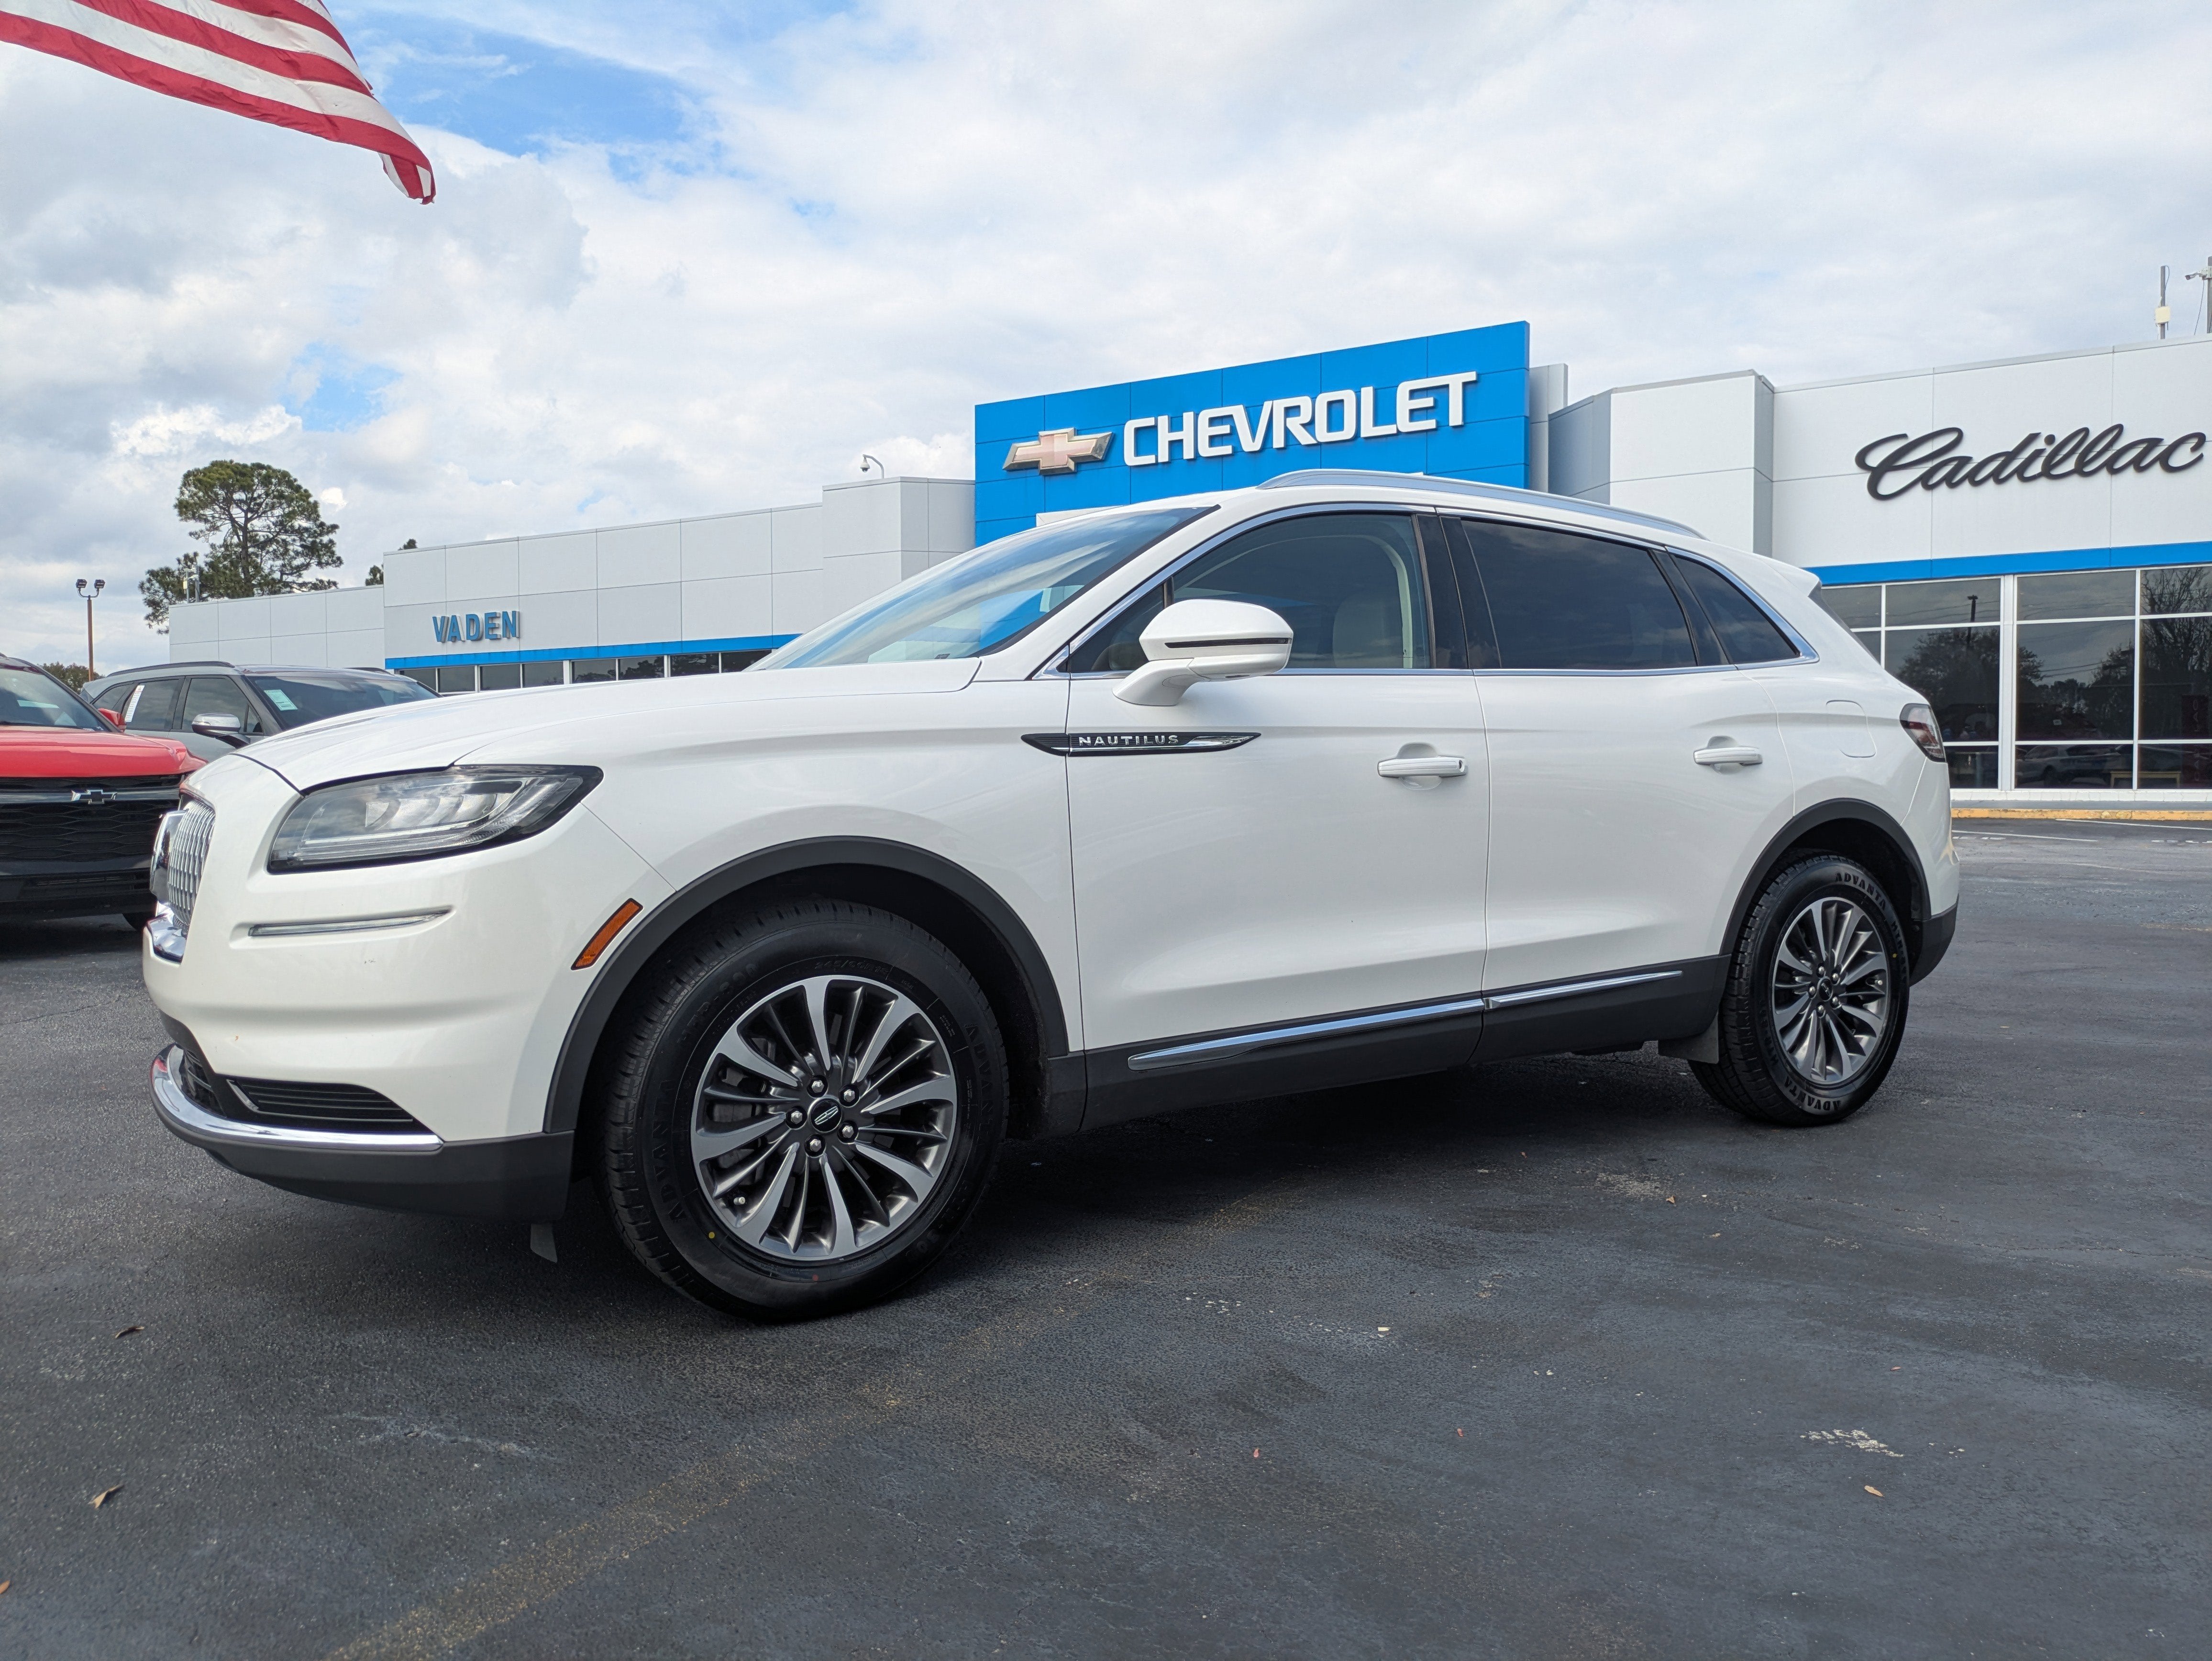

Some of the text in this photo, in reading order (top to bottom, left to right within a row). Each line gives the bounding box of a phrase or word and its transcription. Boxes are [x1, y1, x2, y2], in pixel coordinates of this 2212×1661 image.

[1124, 371, 1477, 466] CHEVROLET
[1855, 423, 2206, 500] Cadillac
[432, 611, 520, 642] VADEN
[1078, 735, 1179, 747] NAUTILUS
[1836, 872, 1886, 911] ADVANTA
[1784, 1076, 1841, 1111] ADVANTA
